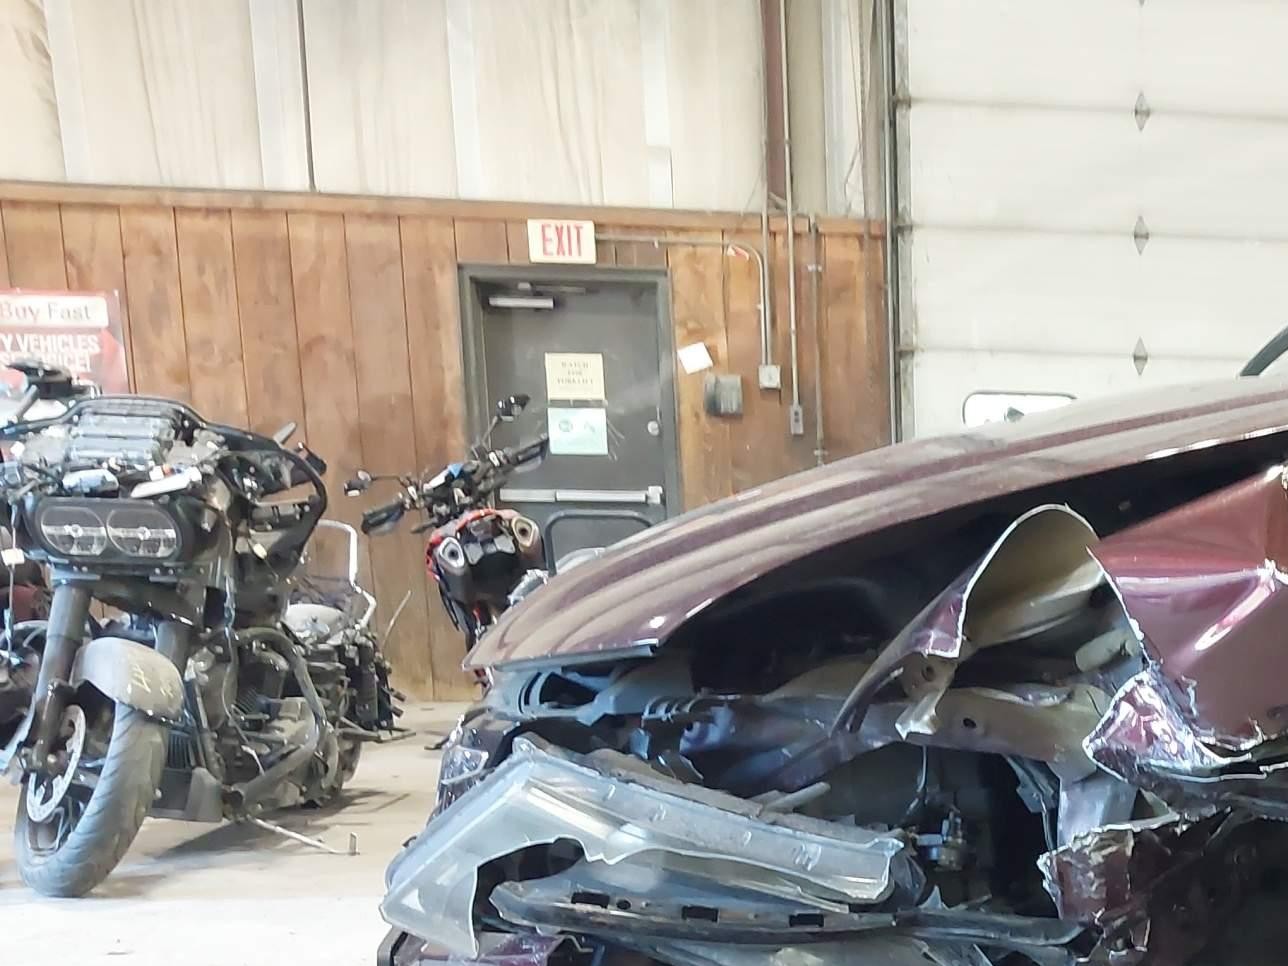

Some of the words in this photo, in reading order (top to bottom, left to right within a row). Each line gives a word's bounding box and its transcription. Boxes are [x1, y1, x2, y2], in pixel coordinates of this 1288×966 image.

[541, 223, 584, 257] EXIT
[47, 301, 91, 320] Fast
[16, 334, 101, 354] VEHICLES
